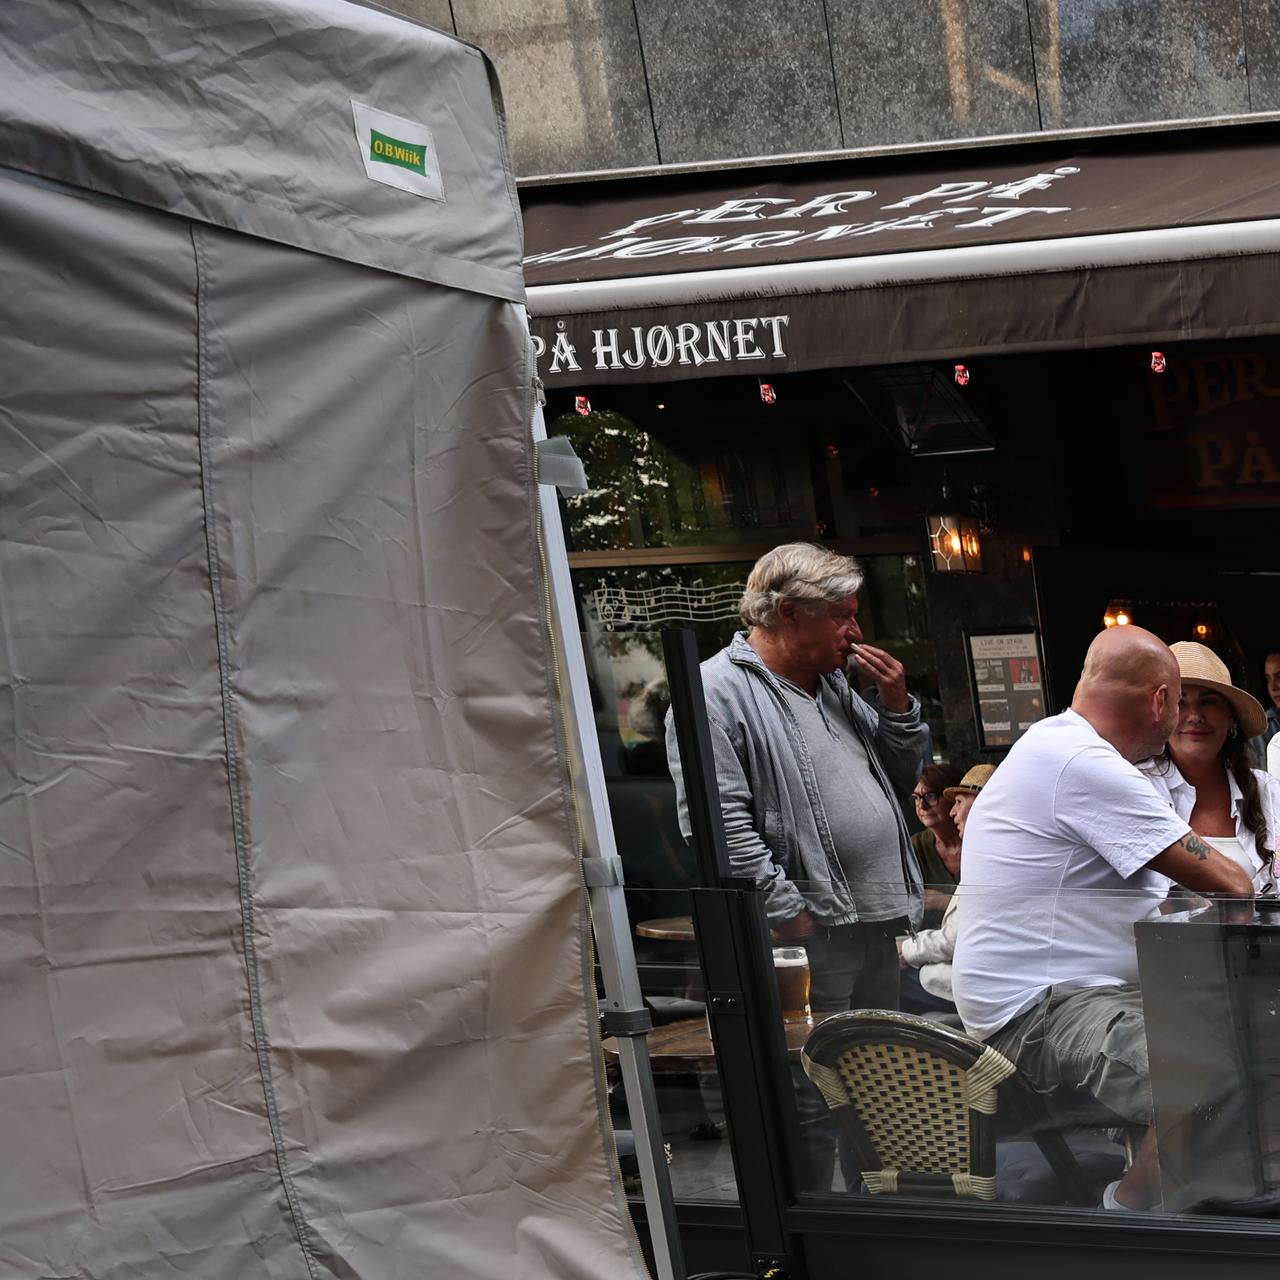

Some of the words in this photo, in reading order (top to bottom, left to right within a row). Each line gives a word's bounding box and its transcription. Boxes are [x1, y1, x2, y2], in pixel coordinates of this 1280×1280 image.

[599, 190, 878, 240] PER
[880, 166, 1081, 210] PÅ
[592, 315, 790, 370] HJØRNET
